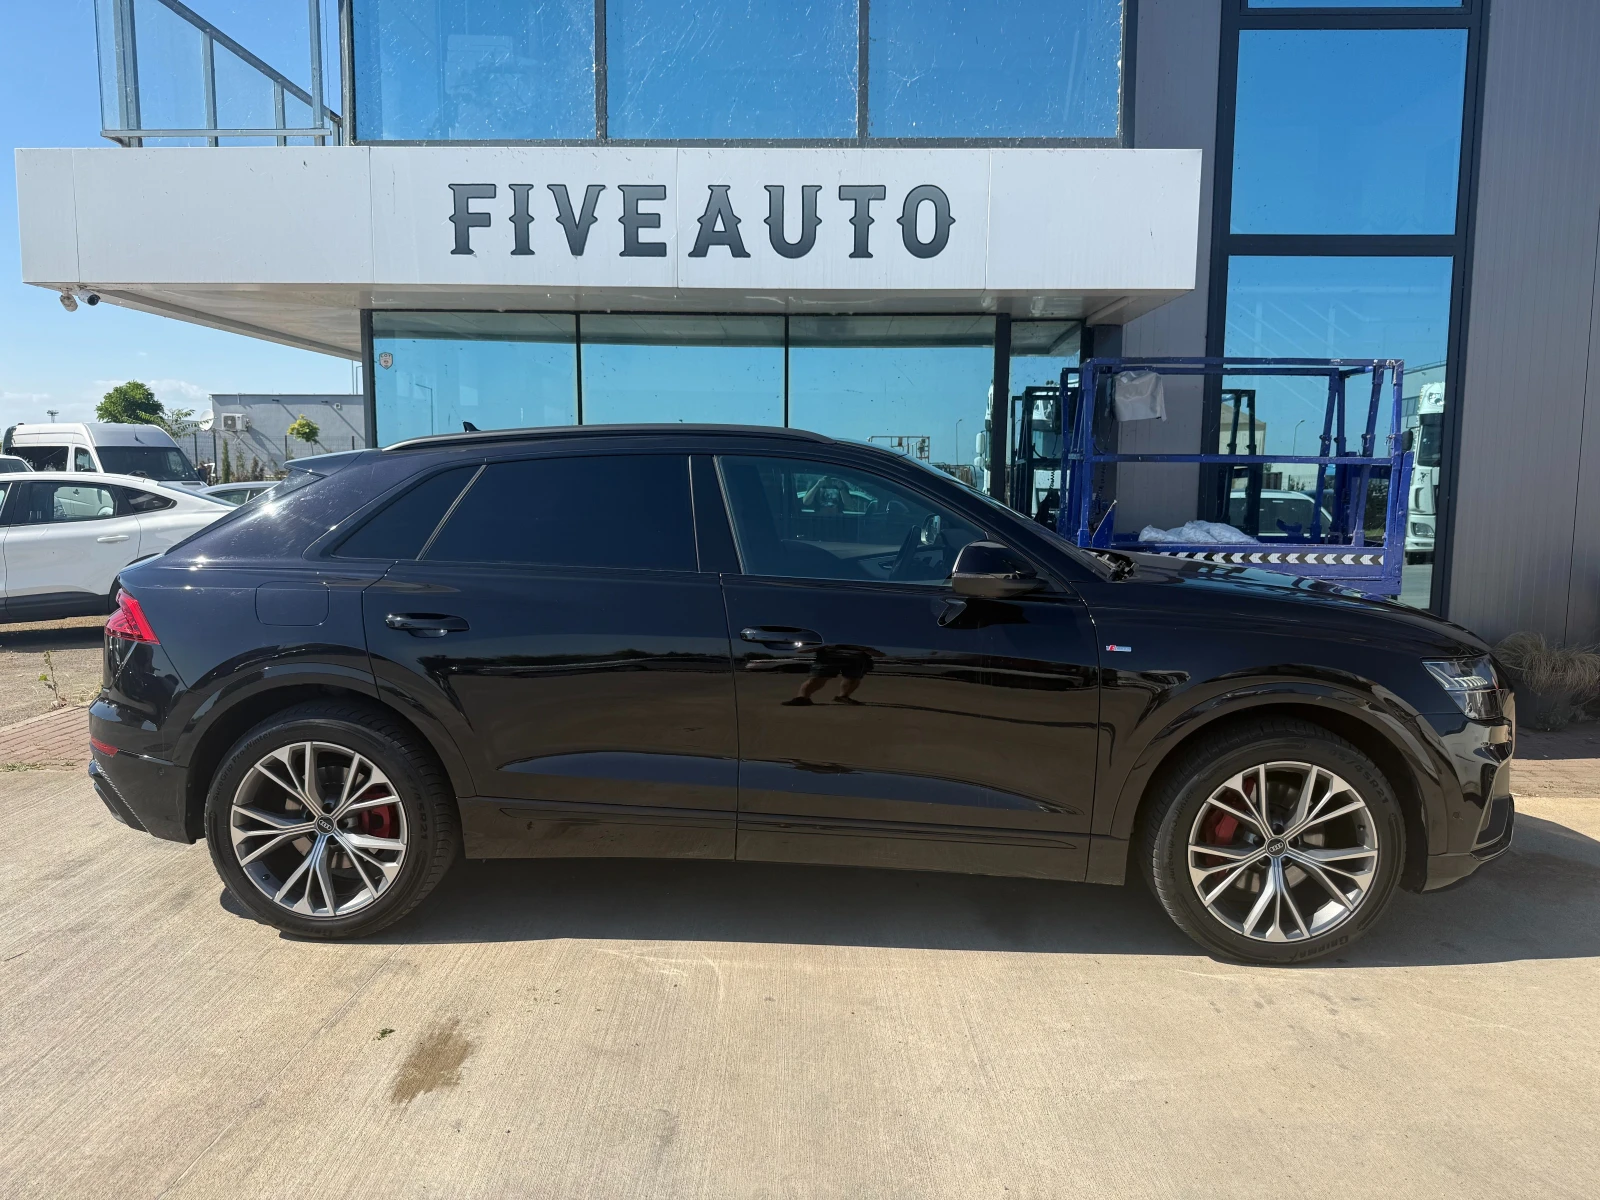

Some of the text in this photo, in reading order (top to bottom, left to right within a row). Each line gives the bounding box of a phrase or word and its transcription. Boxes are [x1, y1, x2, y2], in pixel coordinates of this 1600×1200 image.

[448, 183, 956, 260] FIVEAUTO
[212, 731, 272, 802] SureGrip Pro Winter
[1320, 746, 1389, 804] 5/45R21
